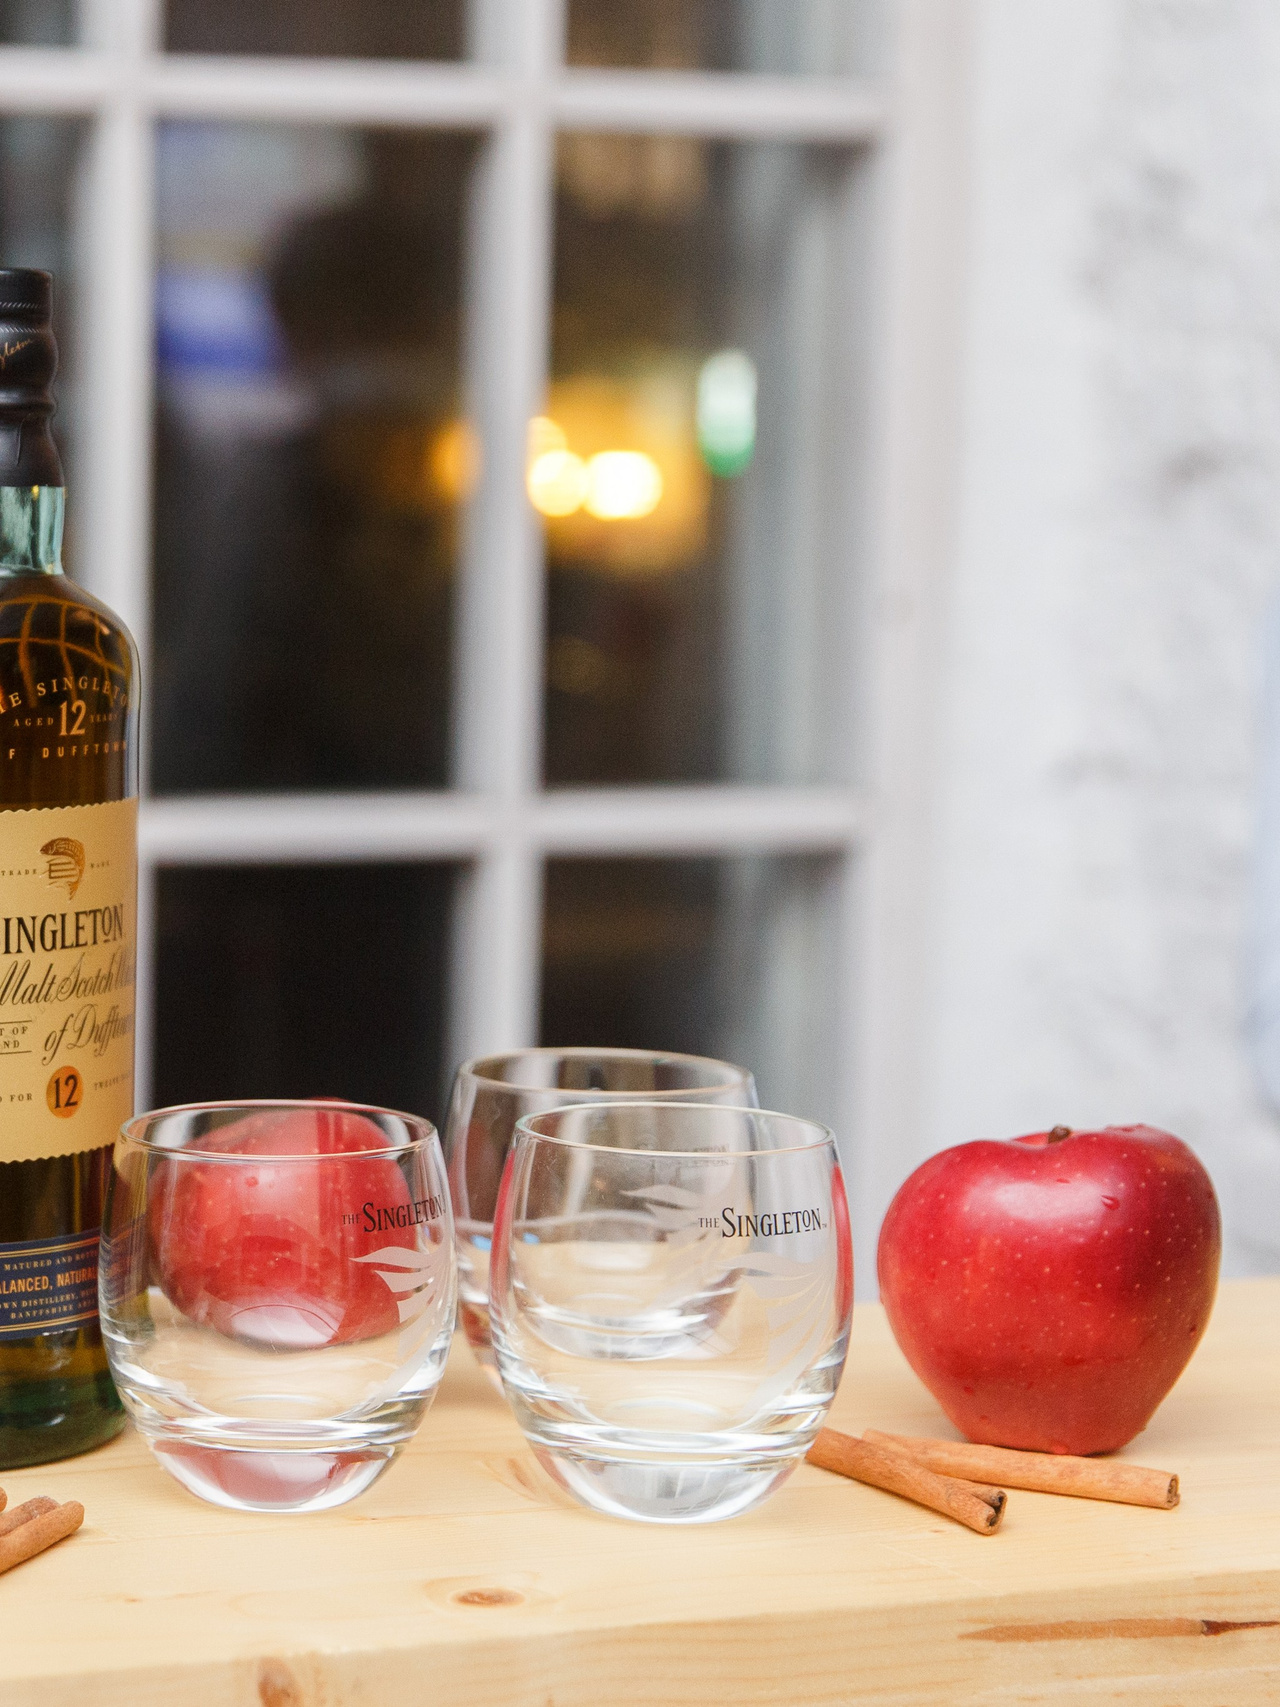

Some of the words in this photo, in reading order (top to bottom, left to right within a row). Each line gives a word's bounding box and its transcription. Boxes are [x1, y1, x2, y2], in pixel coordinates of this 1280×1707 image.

[37, 676, 128, 708] SINGLETO
[14, 717, 54, 727] AGED
[59, 700, 87, 736] 12
[54, 952, 113, 1004] Scotch
[12, 1025, 29, 1036] OF
[41, 1013, 73, 1066] of
[10, 1093, 33, 1102] FOR
[54, 1074, 79, 1110] 12
[342, 1214, 361, 1225] THE
[362, 1195, 444, 1232] SINGLETON
[698, 1218, 719, 1228] THE
[722, 1207, 821, 1238] SINGLETON
[4, 1259, 52, 1272] MATURED
[55, 1255, 73, 1266] AND
[57, 1266, 99, 1287] NATURAL
[10, 1304, 74, 1319] BANFFSHIRE
